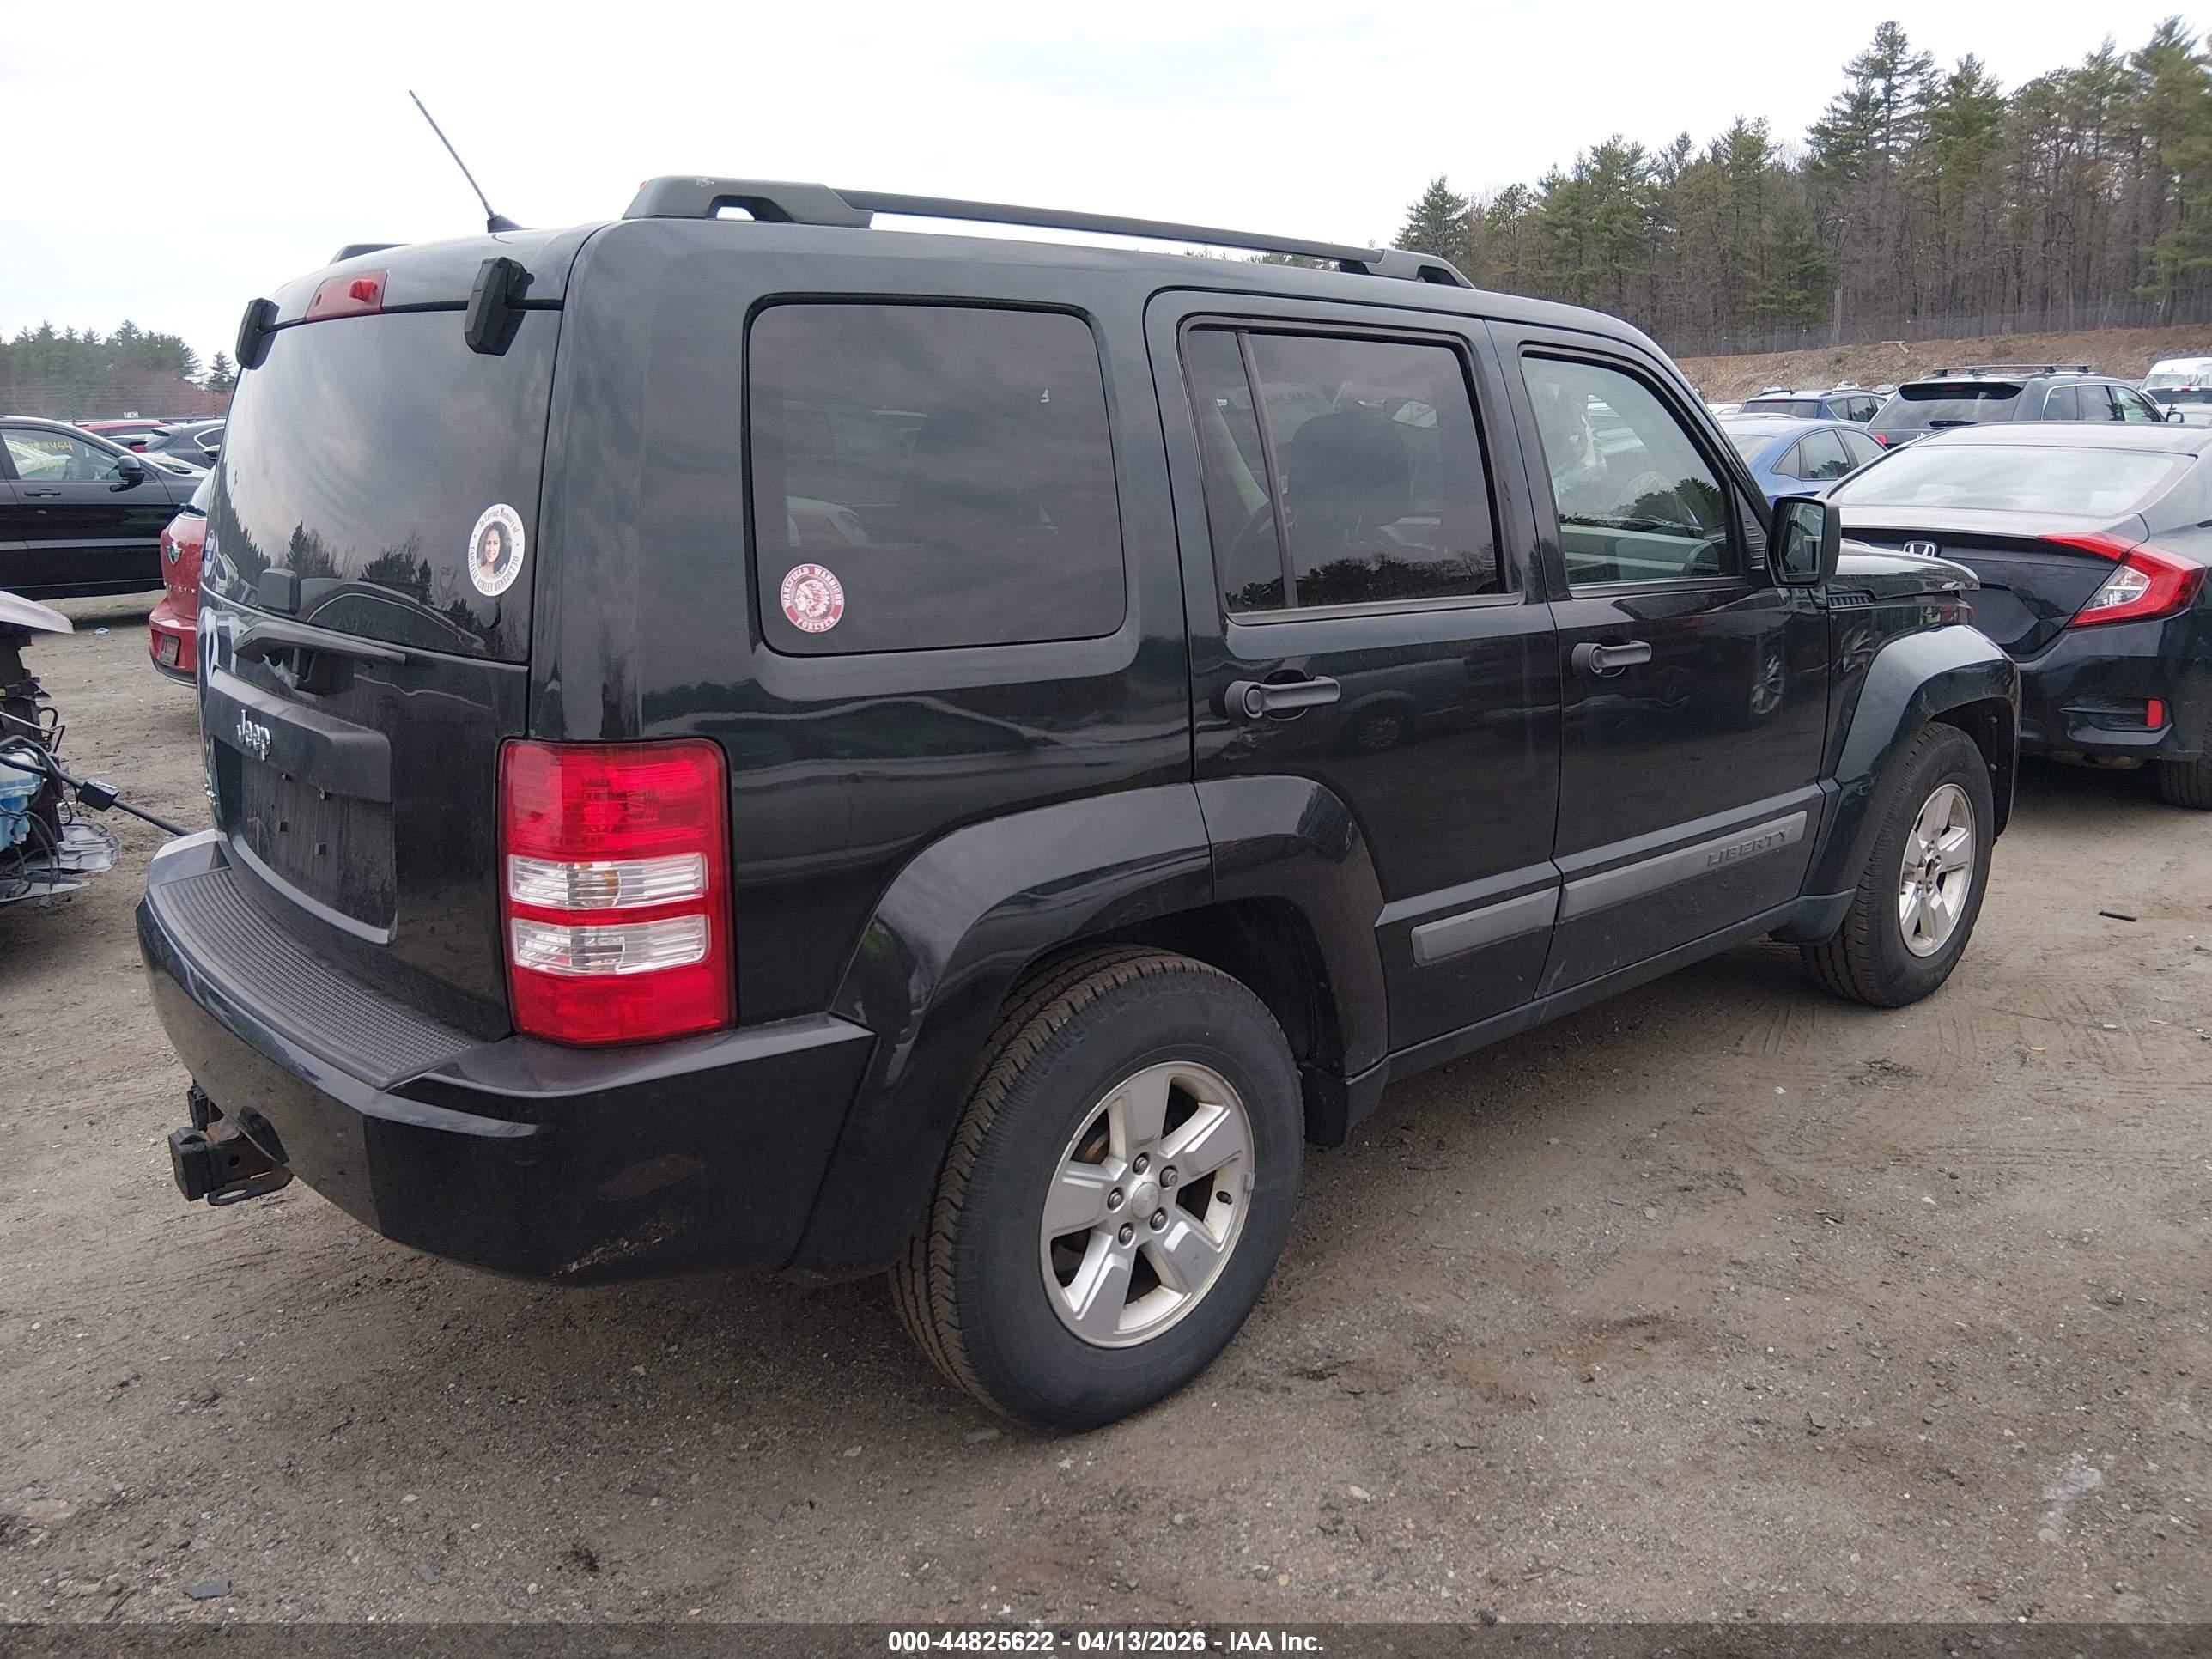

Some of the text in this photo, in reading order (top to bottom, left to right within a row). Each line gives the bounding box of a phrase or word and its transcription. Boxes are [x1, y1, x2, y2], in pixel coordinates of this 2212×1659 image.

[782, 567, 842, 608] WAKEFIELD WARRIORS
[796, 615, 836, 631] FOREVER
[236, 709, 271, 762] Jeep
[1706, 826, 1794, 866] LIBERTY
